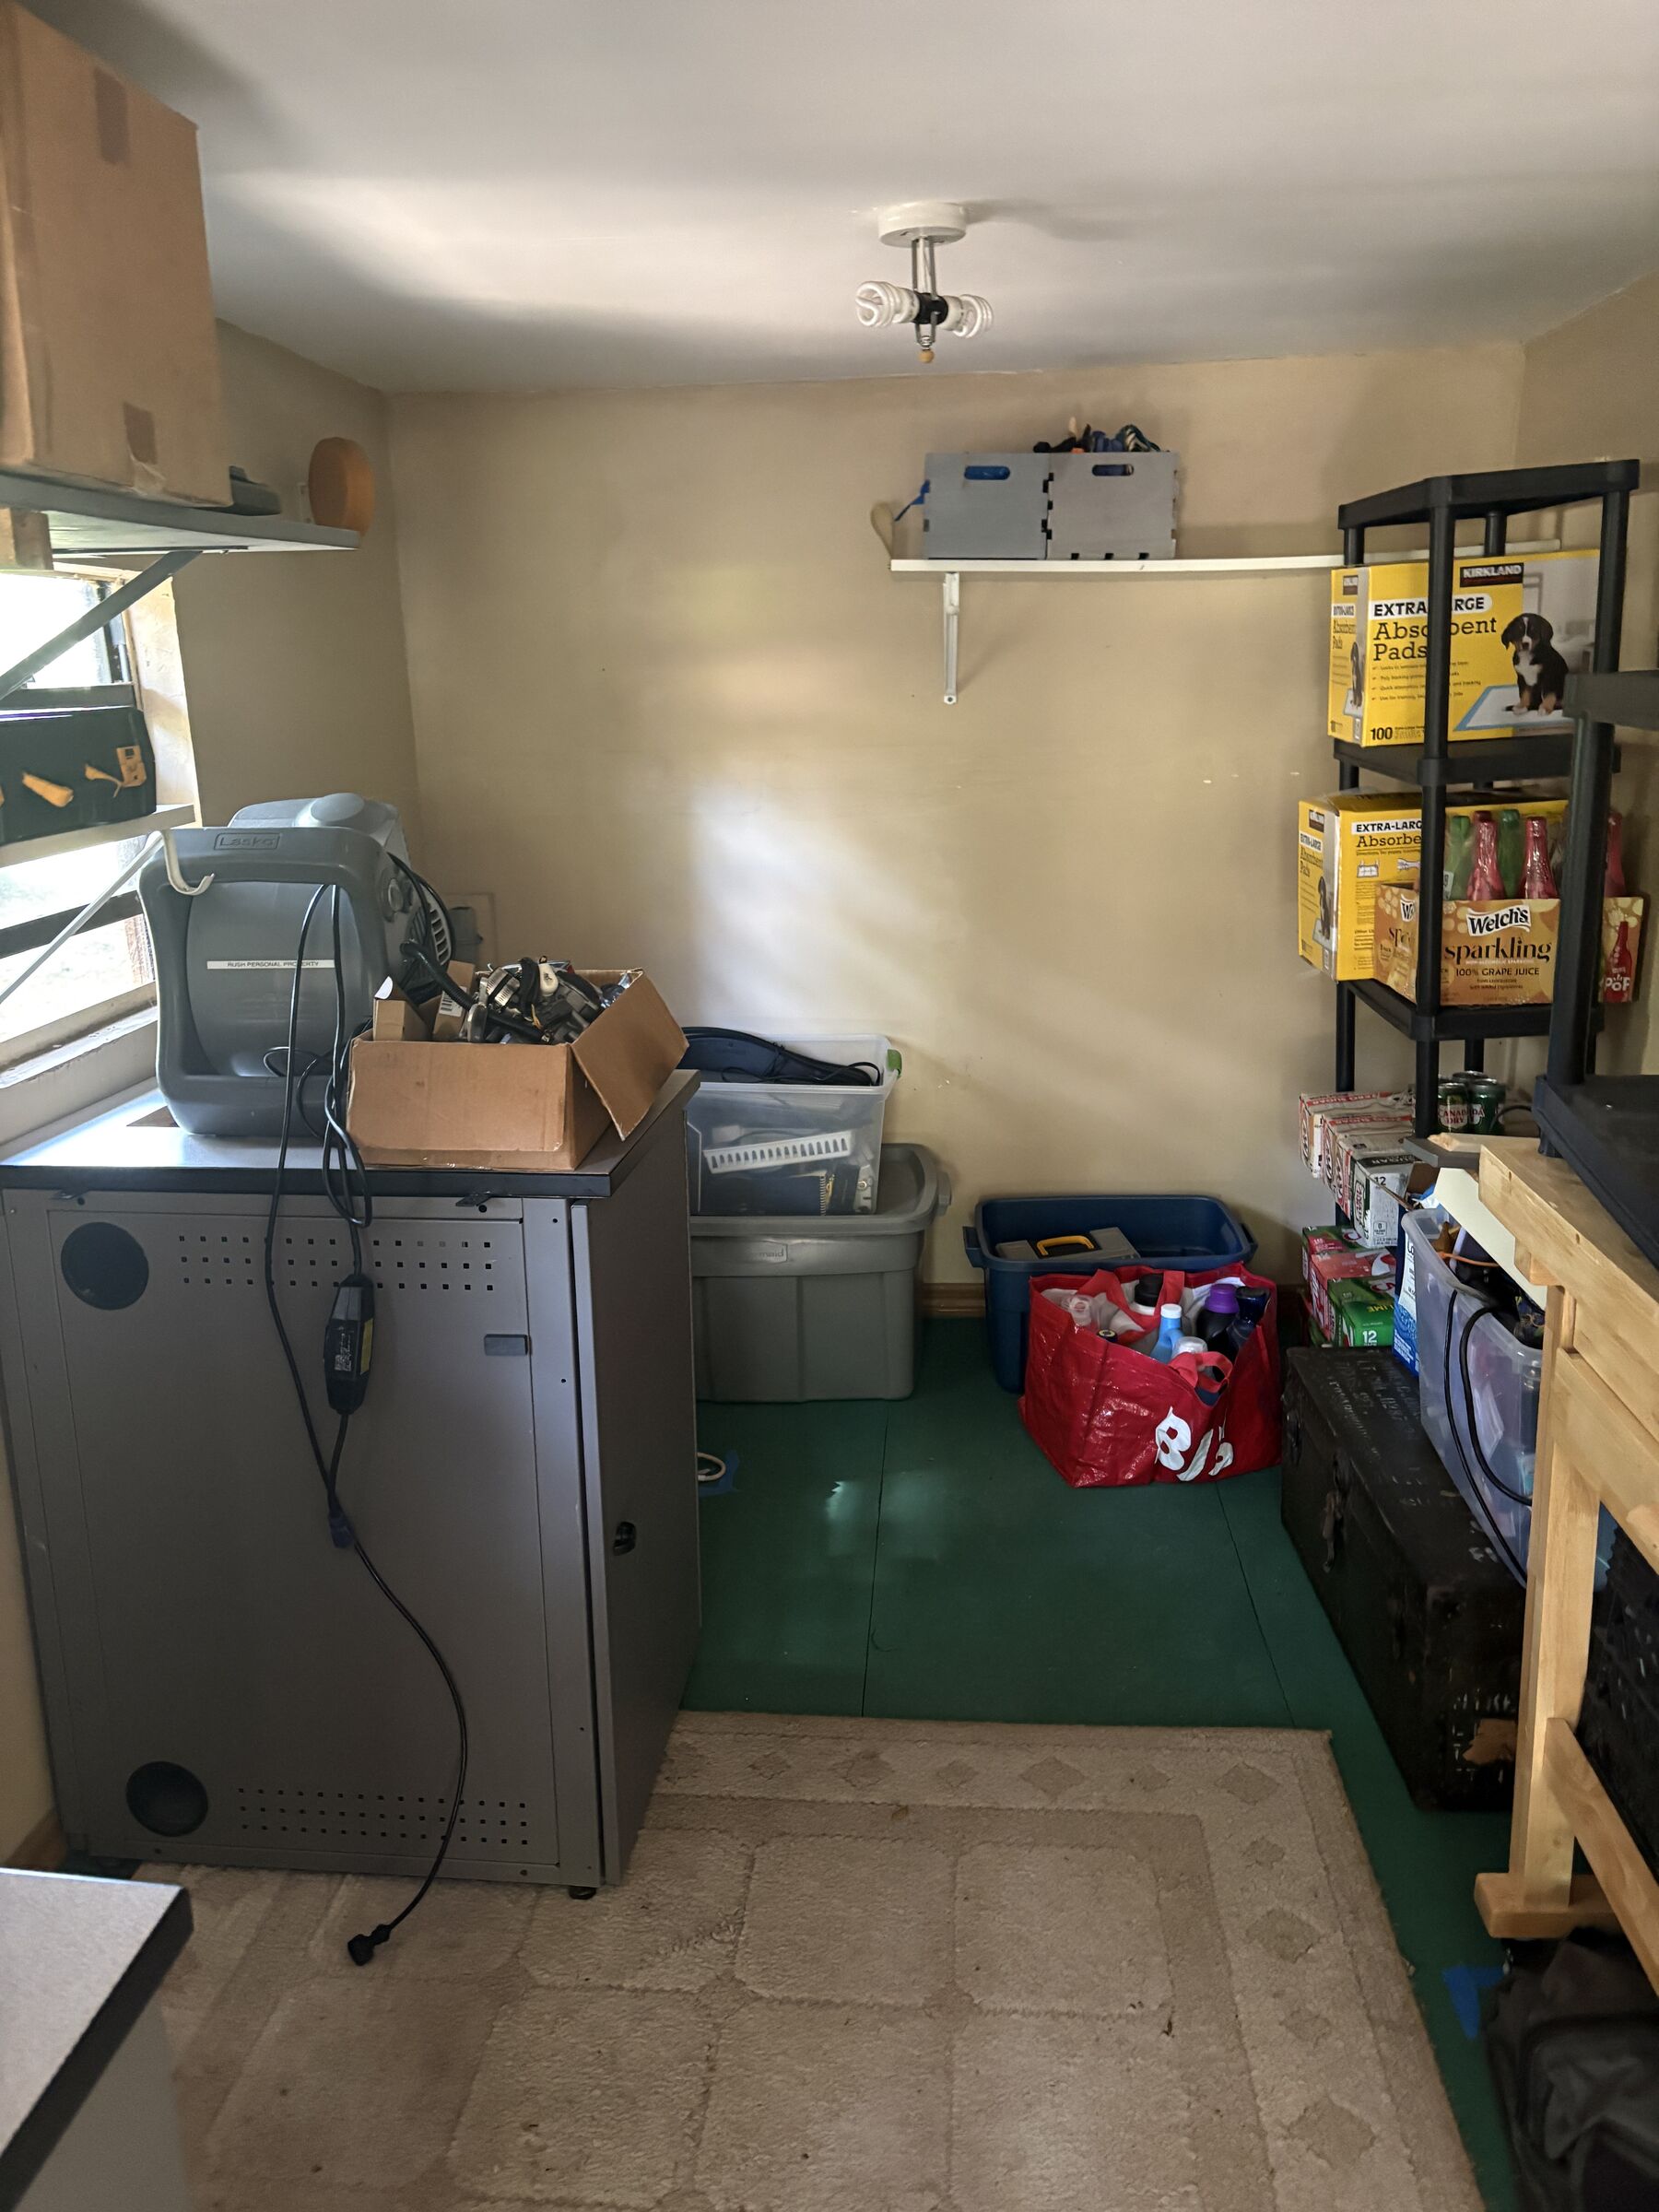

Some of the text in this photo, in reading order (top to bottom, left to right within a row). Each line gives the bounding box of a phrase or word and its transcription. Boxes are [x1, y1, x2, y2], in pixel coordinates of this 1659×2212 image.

[1464, 564, 1523, 579] KIRKLAND
[1371, 727, 1393, 740] 100
[1356, 820, 1422, 832] EXTRA-LARG
[1357, 833, 1422, 848] Absorbe
[1468, 906, 1529, 935] Welch's
[1444, 937, 1552, 966] sparkling
[1456, 968, 1479, 977] 100%
[1481, 967, 1512, 977] GRAPE
[1515, 967, 1540, 976] JUICE
[1605, 977, 1630, 992] POP
[1373, 1176, 1386, 1186] 12
[1362, 1330, 1378, 1344] 12
